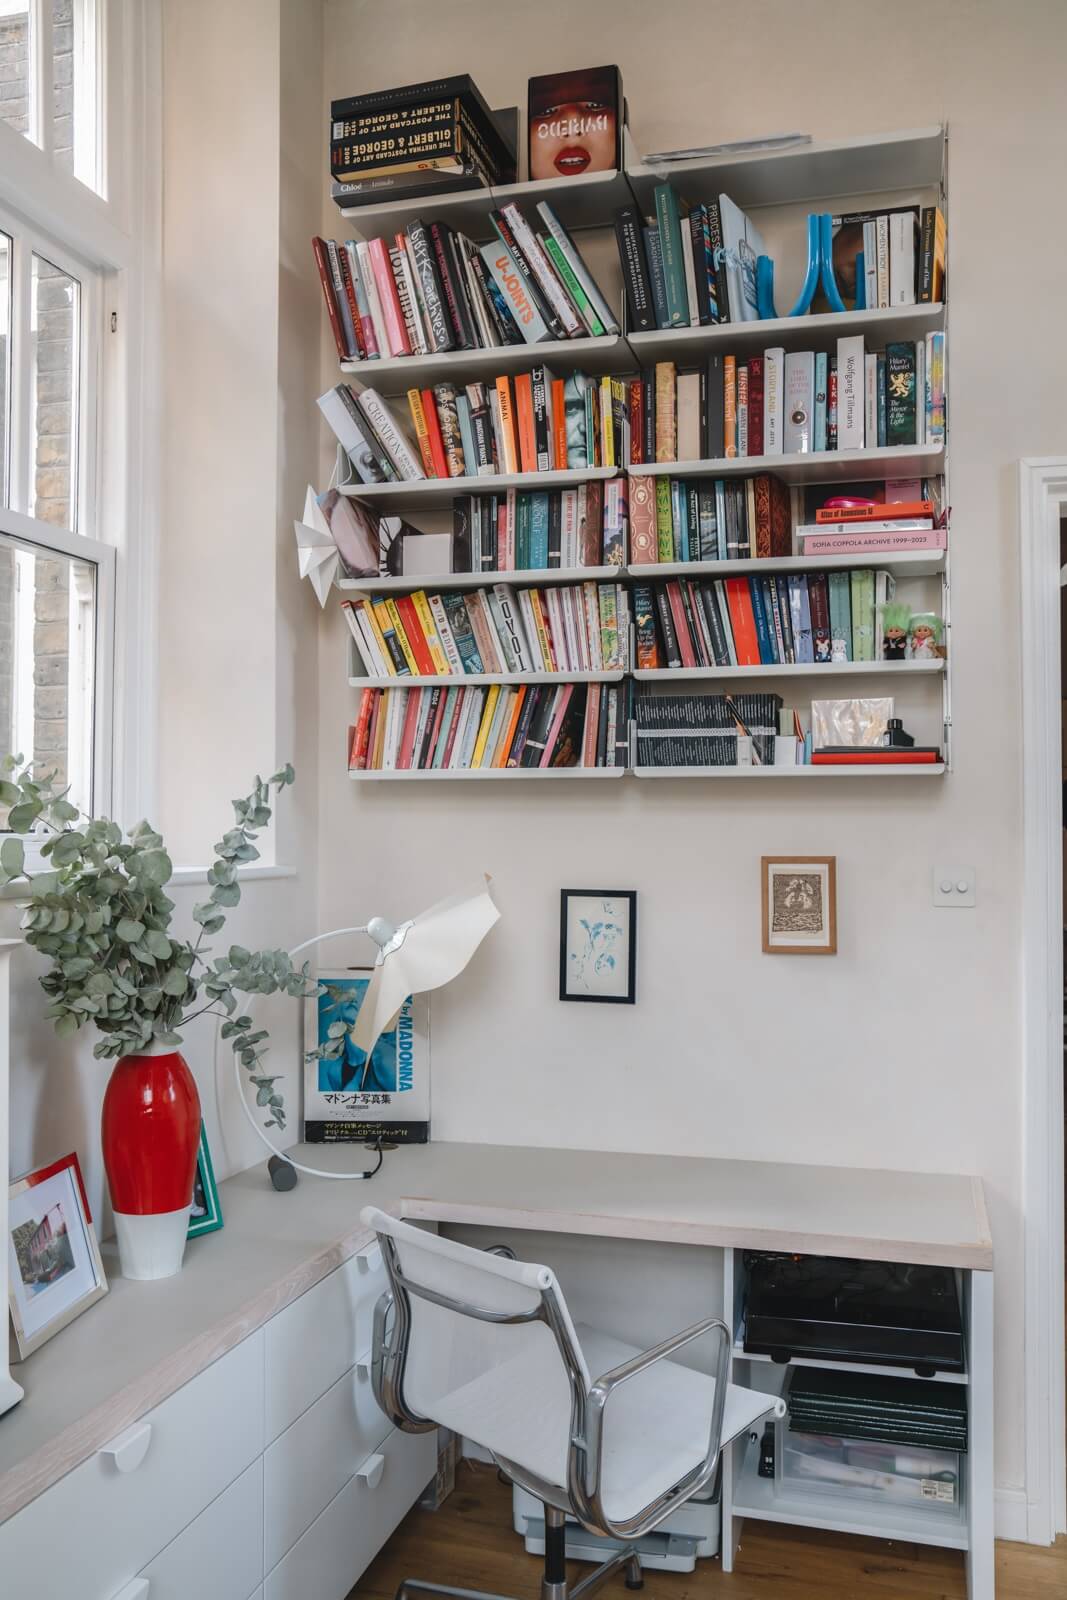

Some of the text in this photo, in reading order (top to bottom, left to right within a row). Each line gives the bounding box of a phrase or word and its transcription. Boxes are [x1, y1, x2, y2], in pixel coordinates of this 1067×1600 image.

[359, 114, 399, 126] GEORGE
[410, 104, 451, 116] GILBERT
[372, 125, 387, 133] ART
[390, 116, 433, 128] POSTCARD
[538, 115, 608, 139] BYREDO
[352, 129, 451, 155] GILBERT & GEORGE
[376, 148, 408, 159] POSTCARD
[409, 144, 440, 154] URETHRA
[362, 154, 374, 162] ART
[708, 204, 722, 249] PROCESS
[625, 237, 633, 259] DESIGN
[628, 223, 640, 272] MANUFACTURING
[510, 245, 521, 258] RAY
[517, 257, 531, 276] PETRI
[494, 254, 536, 326] U-JOINTS
[768, 364, 776, 414] STORYLAND
[845, 355, 856, 429] Wolfgang Tillmans
[499, 390, 509, 422] ANIMAL
[366, 399, 401, 457] CREATION
[832, 539, 862, 547] COPPOLA
[498, 601, 530, 673] TOAD
[431, 688, 440, 706] 10:04
[400, 1006, 411, 1016] by
[399, 1016, 413, 1091] MADONNA
[323, 1093, 392, 1105] マドンナ写真集
